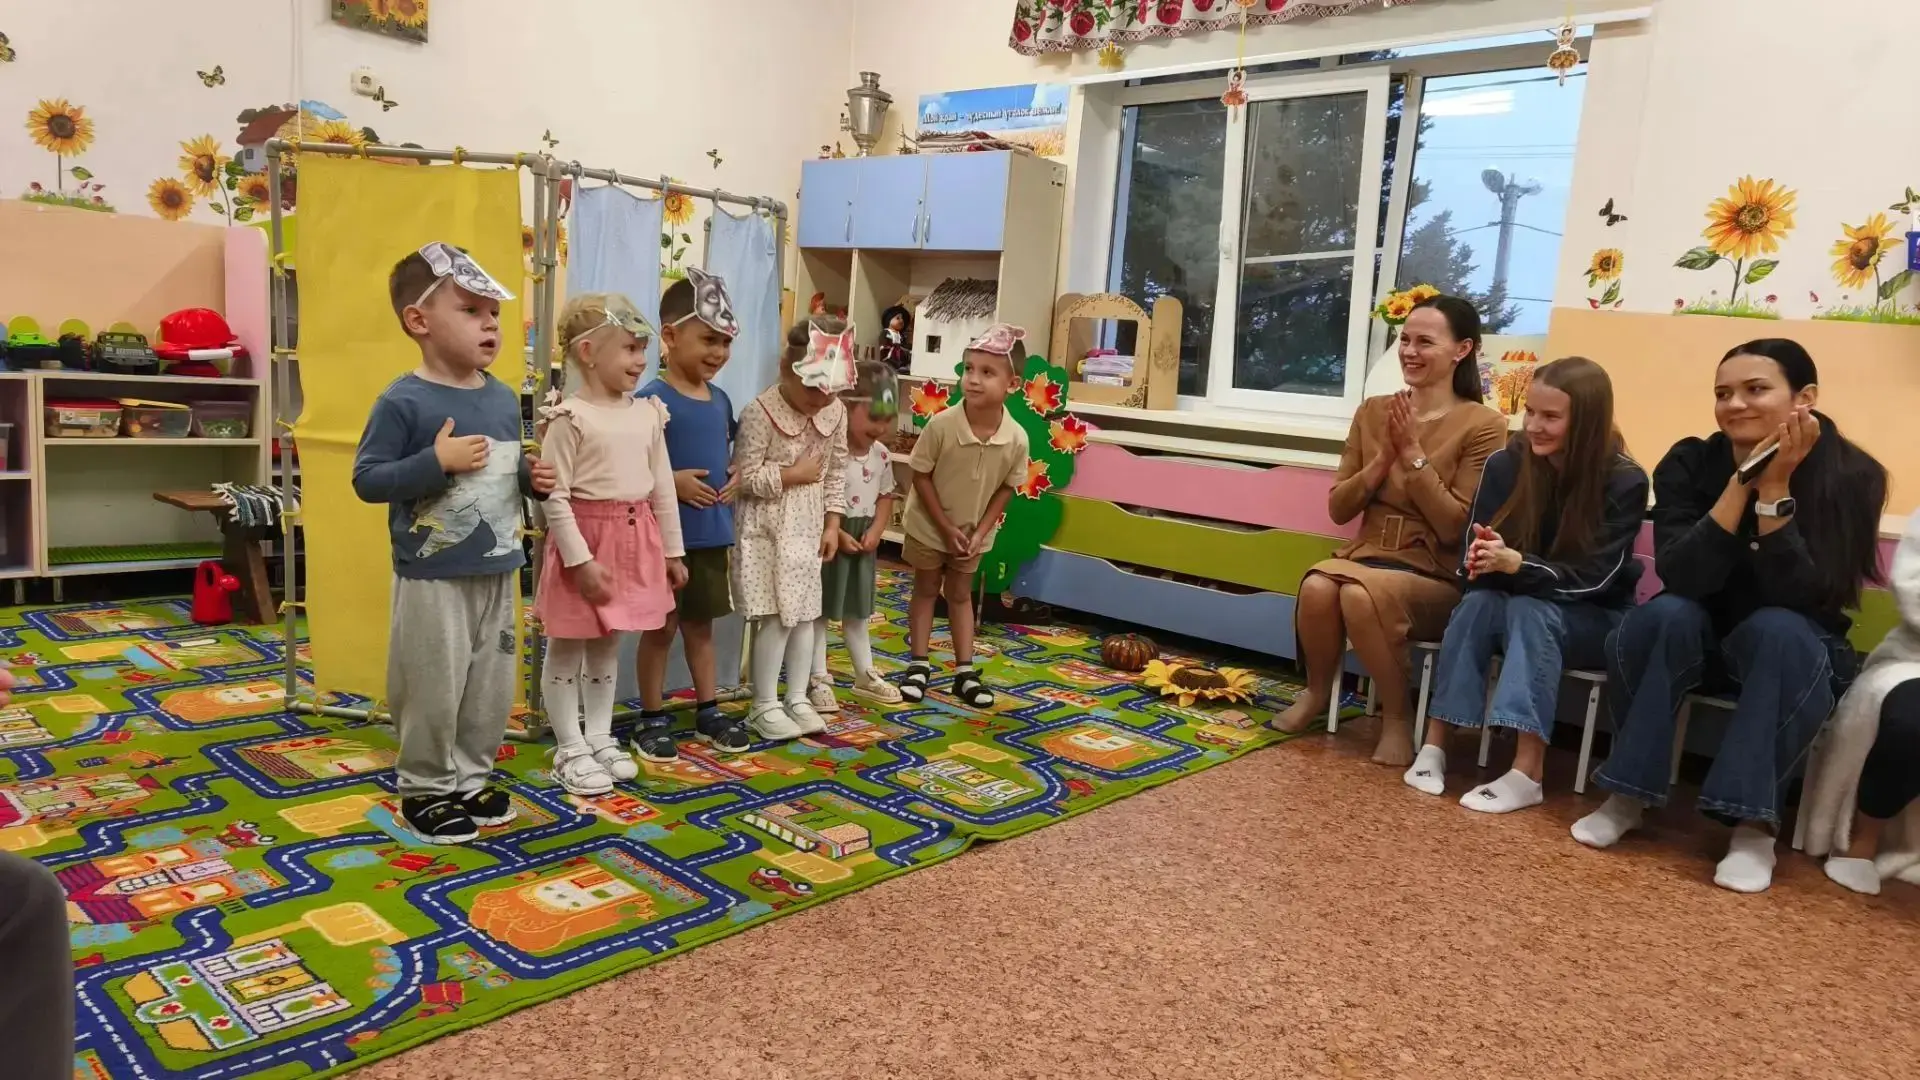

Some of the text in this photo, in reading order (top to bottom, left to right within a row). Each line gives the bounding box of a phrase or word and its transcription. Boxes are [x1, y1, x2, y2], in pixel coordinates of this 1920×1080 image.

[923, 112, 939, 124] Мой
[940, 111, 958, 126] край
[967, 109, 1002, 124] чудесный
[1003, 107, 1030, 122] уголок
